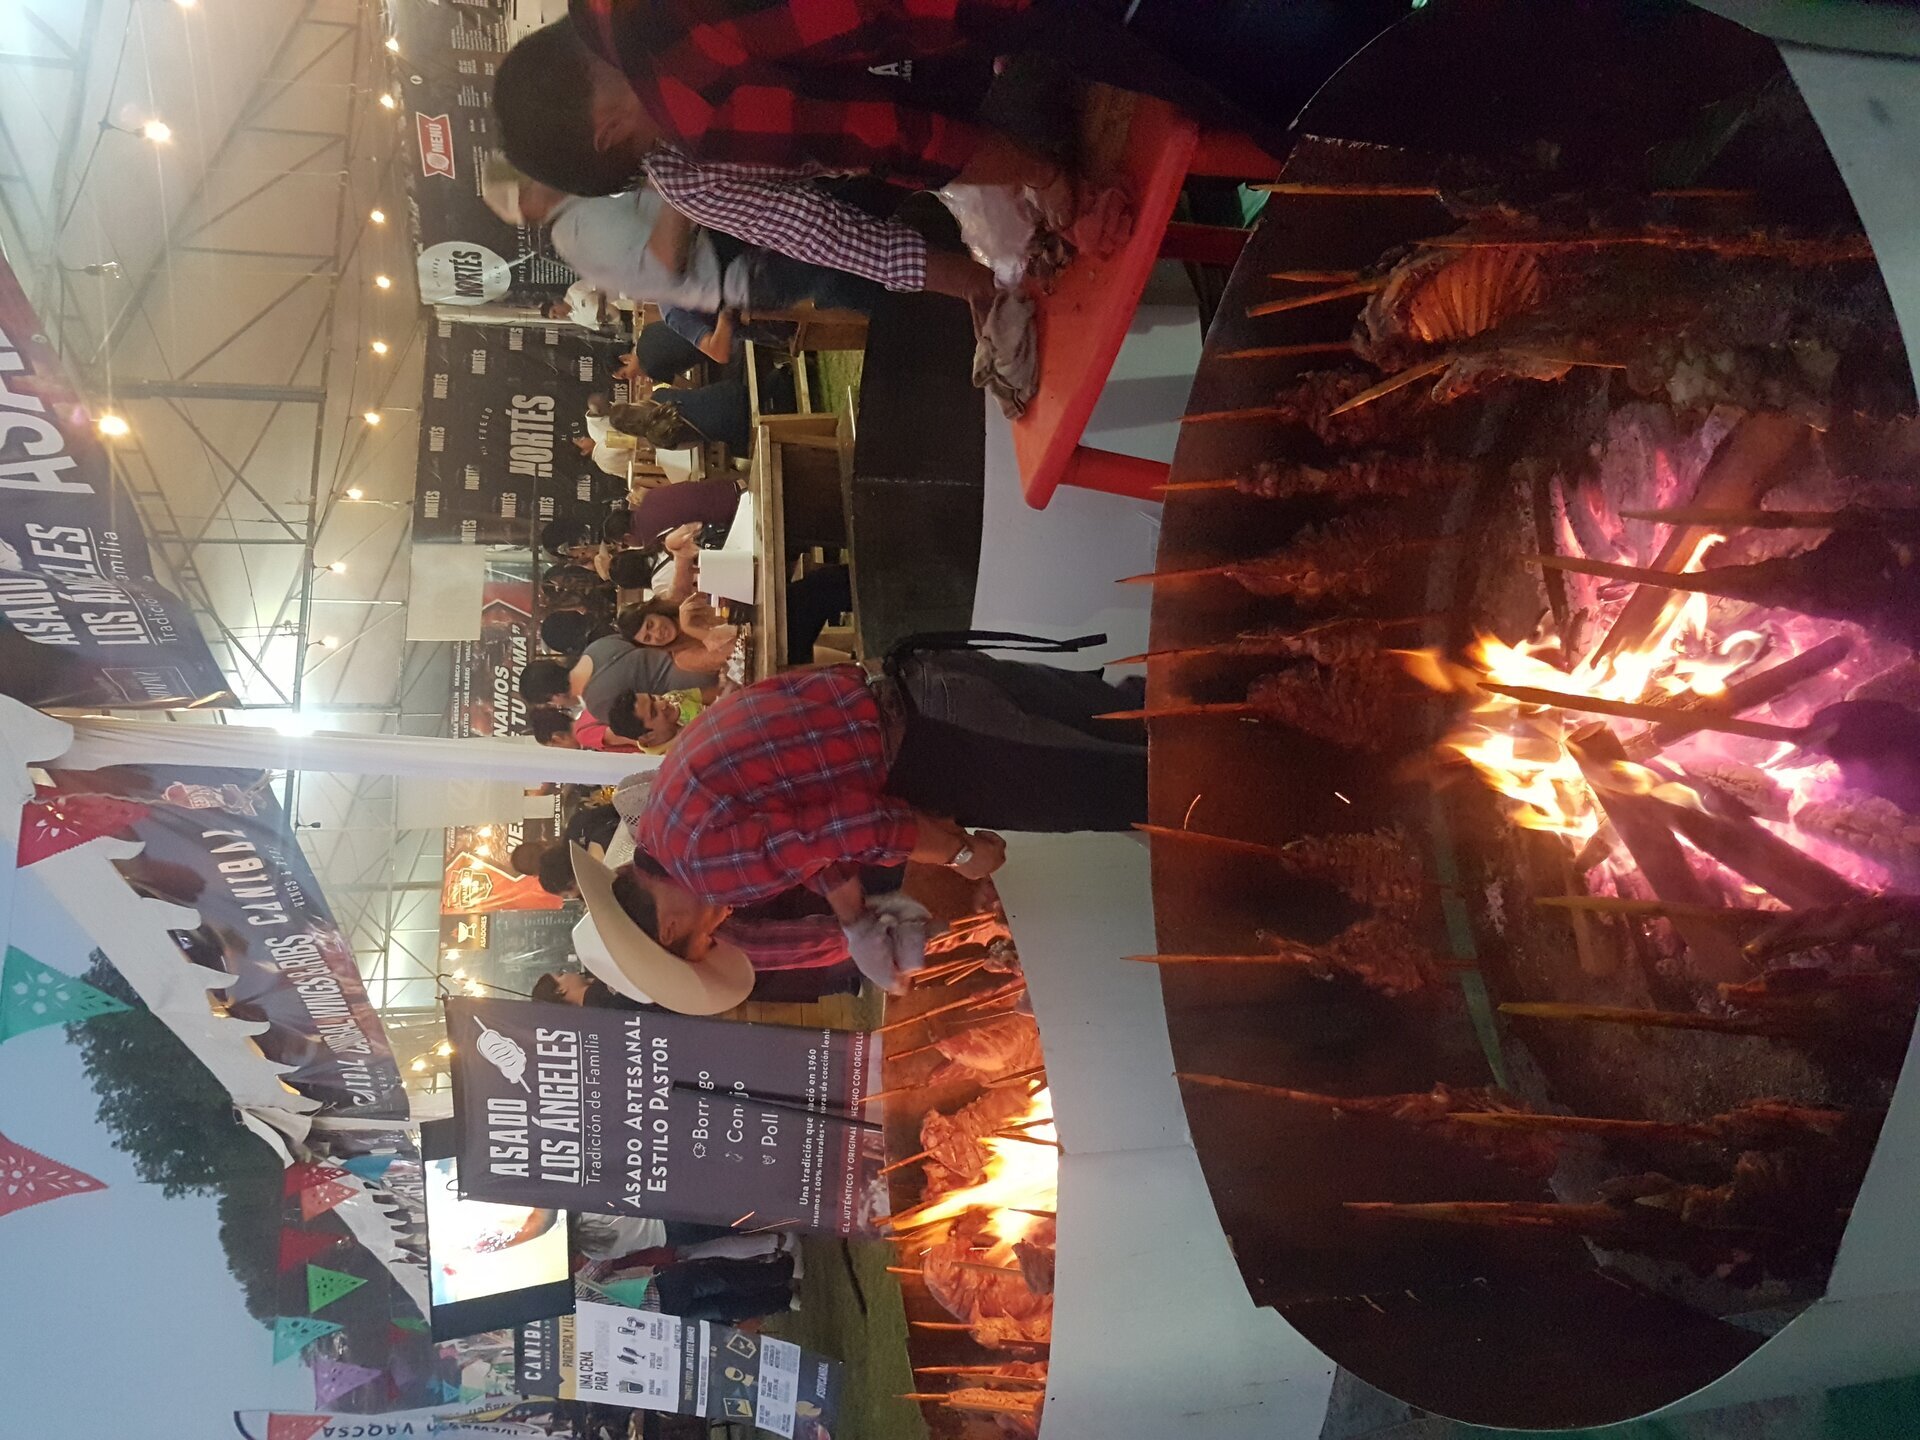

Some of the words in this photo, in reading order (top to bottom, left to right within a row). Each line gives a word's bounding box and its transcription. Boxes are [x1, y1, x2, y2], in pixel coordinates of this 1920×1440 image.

[425, 123, 444, 153] MENÚ
[448, 251, 484, 298] NORTÉS
[479, 407, 493, 440] FUEGO
[505, 394, 555, 478] NORTÉS
[461, 520, 476, 544] ORTÉS
[25, 523, 130, 604] ÁNELES
[98, 531, 130, 580] amilia
[80, 610, 150, 644] LOS
[137, 592, 177, 644] Tradició
[462, 692, 470, 707] JOSÉ
[511, 698, 526, 725] TU
[202, 829, 289, 926] CANIBAL
[480, 916, 488, 948] ASADORES
[264, 934, 326, 969] RIBS
[293, 976, 350, 1018] WINGS
[585, 1033, 600, 1085] Familia
[623, 1016, 643, 1130] ARTESANAL
[649, 1037, 669, 1110] PASTOR
[807, 1049, 816, 1070] 1960
[821, 1050, 829, 1079] cocción
[336, 1060, 377, 1106] CAIBAL
[532, 1028, 580, 1133] ÁNGELES
[808, 1073, 815, 1085] en
[819, 1082, 828, 1091] de
[852, 1068, 860, 1086] CON
[586, 1091, 600, 1108] de
[692, 1071, 714, 1139] Borrgo
[726, 1081, 749, 1143] Conjo
[851, 1088, 859, 1117] HECHO
[488, 1098, 530, 1178] ASADO
[761, 1112, 779, 1146] Poll
[806, 1117, 815, 1135] que
[540, 1139, 580, 1184] LOS
[585, 1115, 601, 1184] Tradición
[647, 1119, 668, 1192] ESTILO
[816, 1129, 825, 1168] naturales
[622, 1138, 643, 1208] ASADO
[814, 1170, 822, 1191] 100%
[799, 1186, 809, 1205] Una
[811, 1194, 820, 1227] insumos
[842, 1173, 854, 1220] AUTÉNTICO
[842, 1221, 850, 1232] EL
[524, 1320, 541, 1380] CANIBA
[562, 1335, 574, 1367] PARTICIPA
[579, 1351, 594, 1372] CENA
[579, 1374, 593, 1389] UNA
[594, 1372, 608, 1391] PARA
